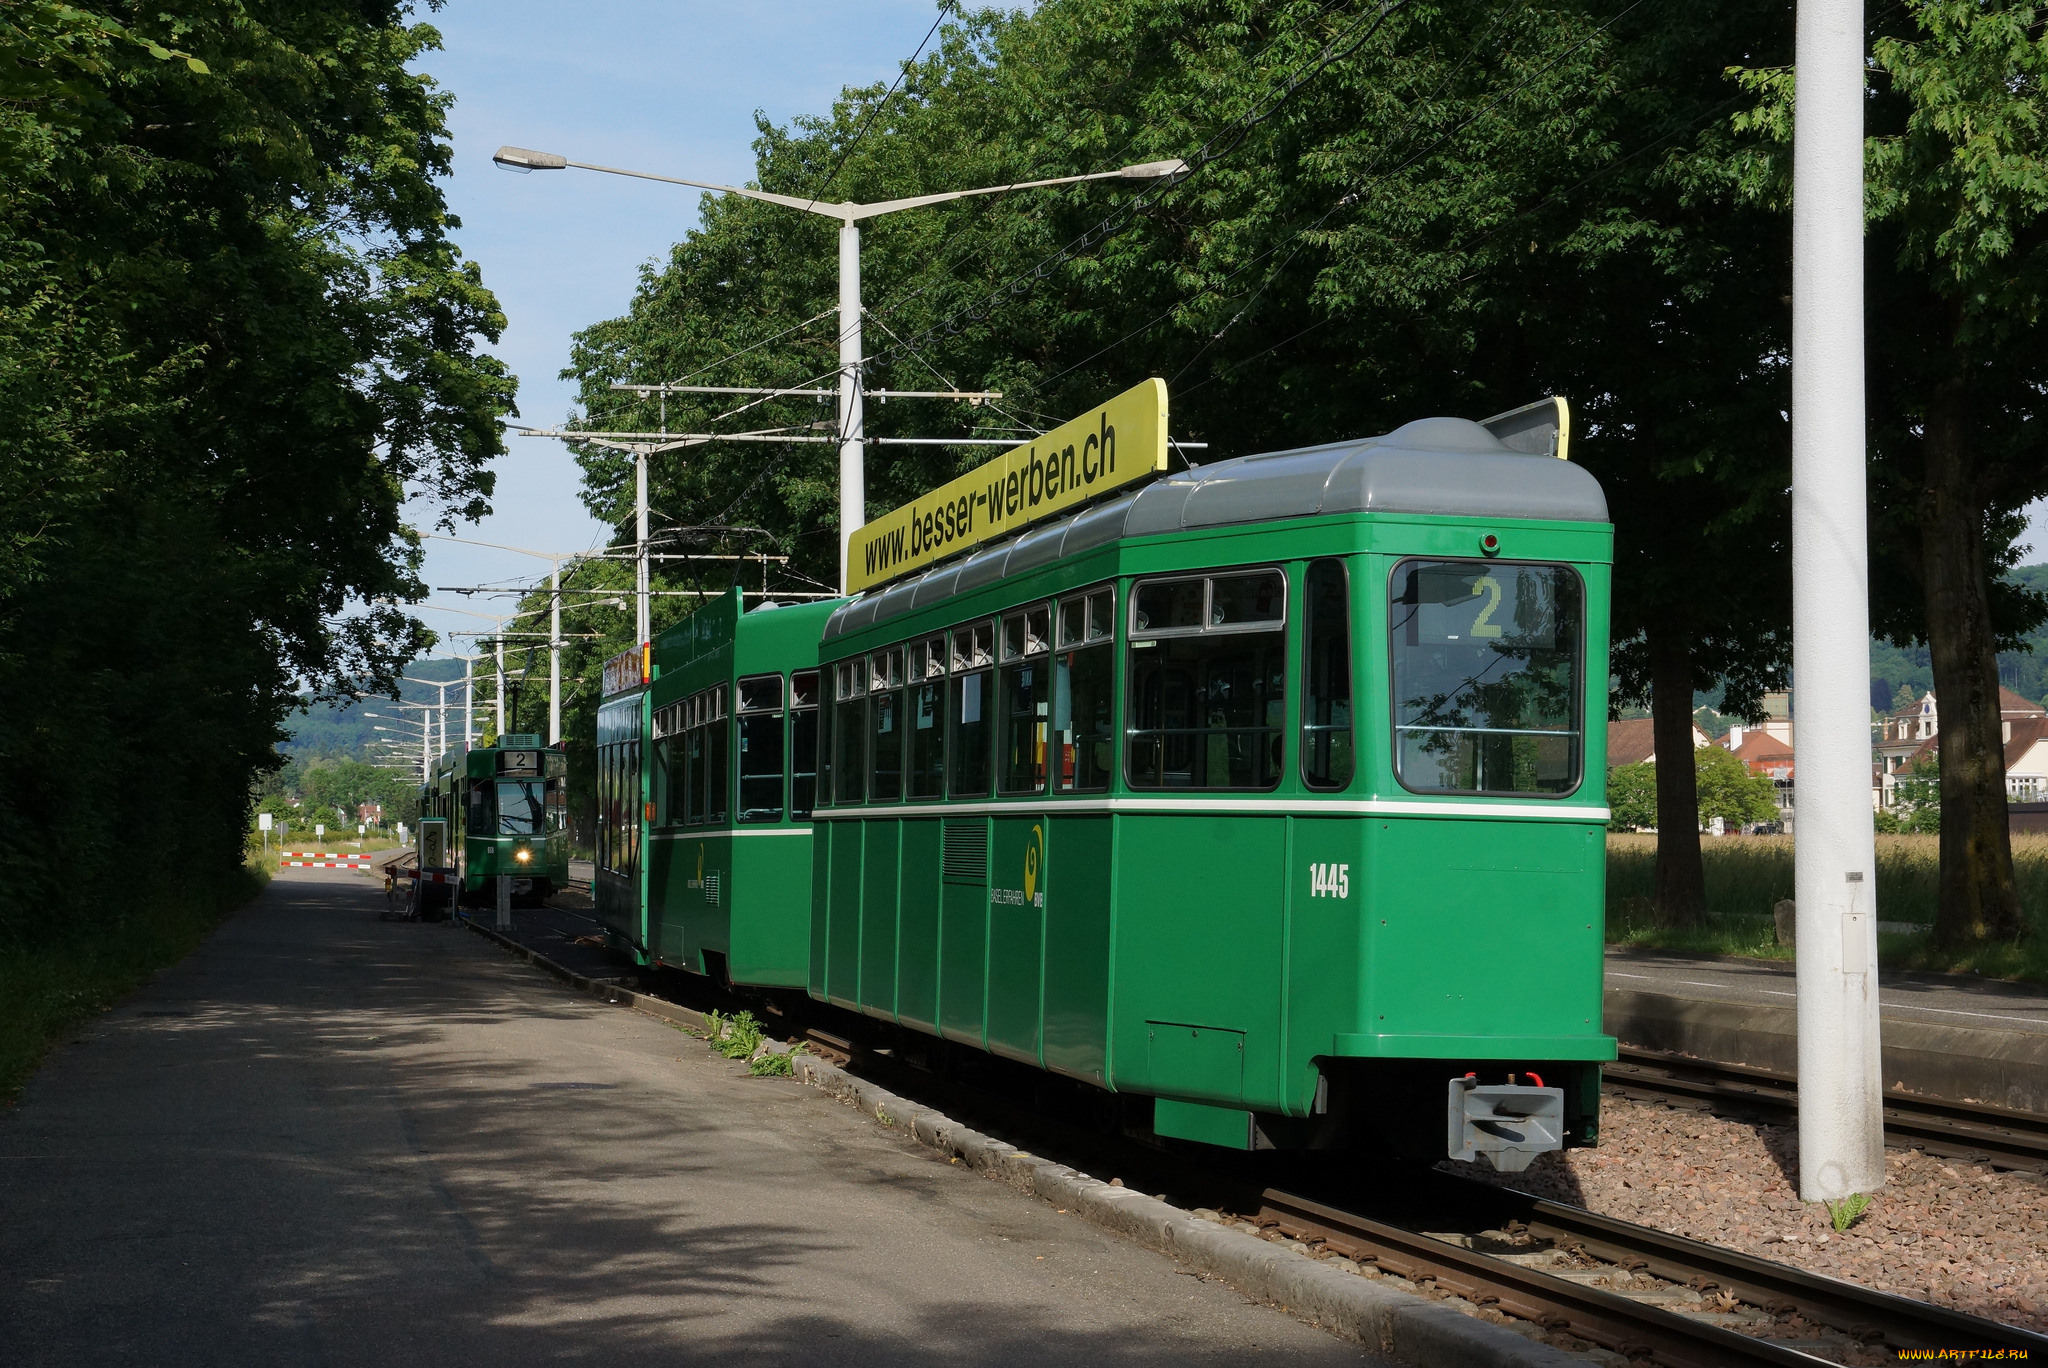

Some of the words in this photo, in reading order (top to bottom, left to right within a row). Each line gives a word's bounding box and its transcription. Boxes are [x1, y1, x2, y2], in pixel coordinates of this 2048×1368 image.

[865, 412, 1116, 576] www.besser-werben.ch
[1470, 575, 1502, 638] 2
[516, 753, 526, 767] 2
[1310, 863, 1349, 899] 1445
